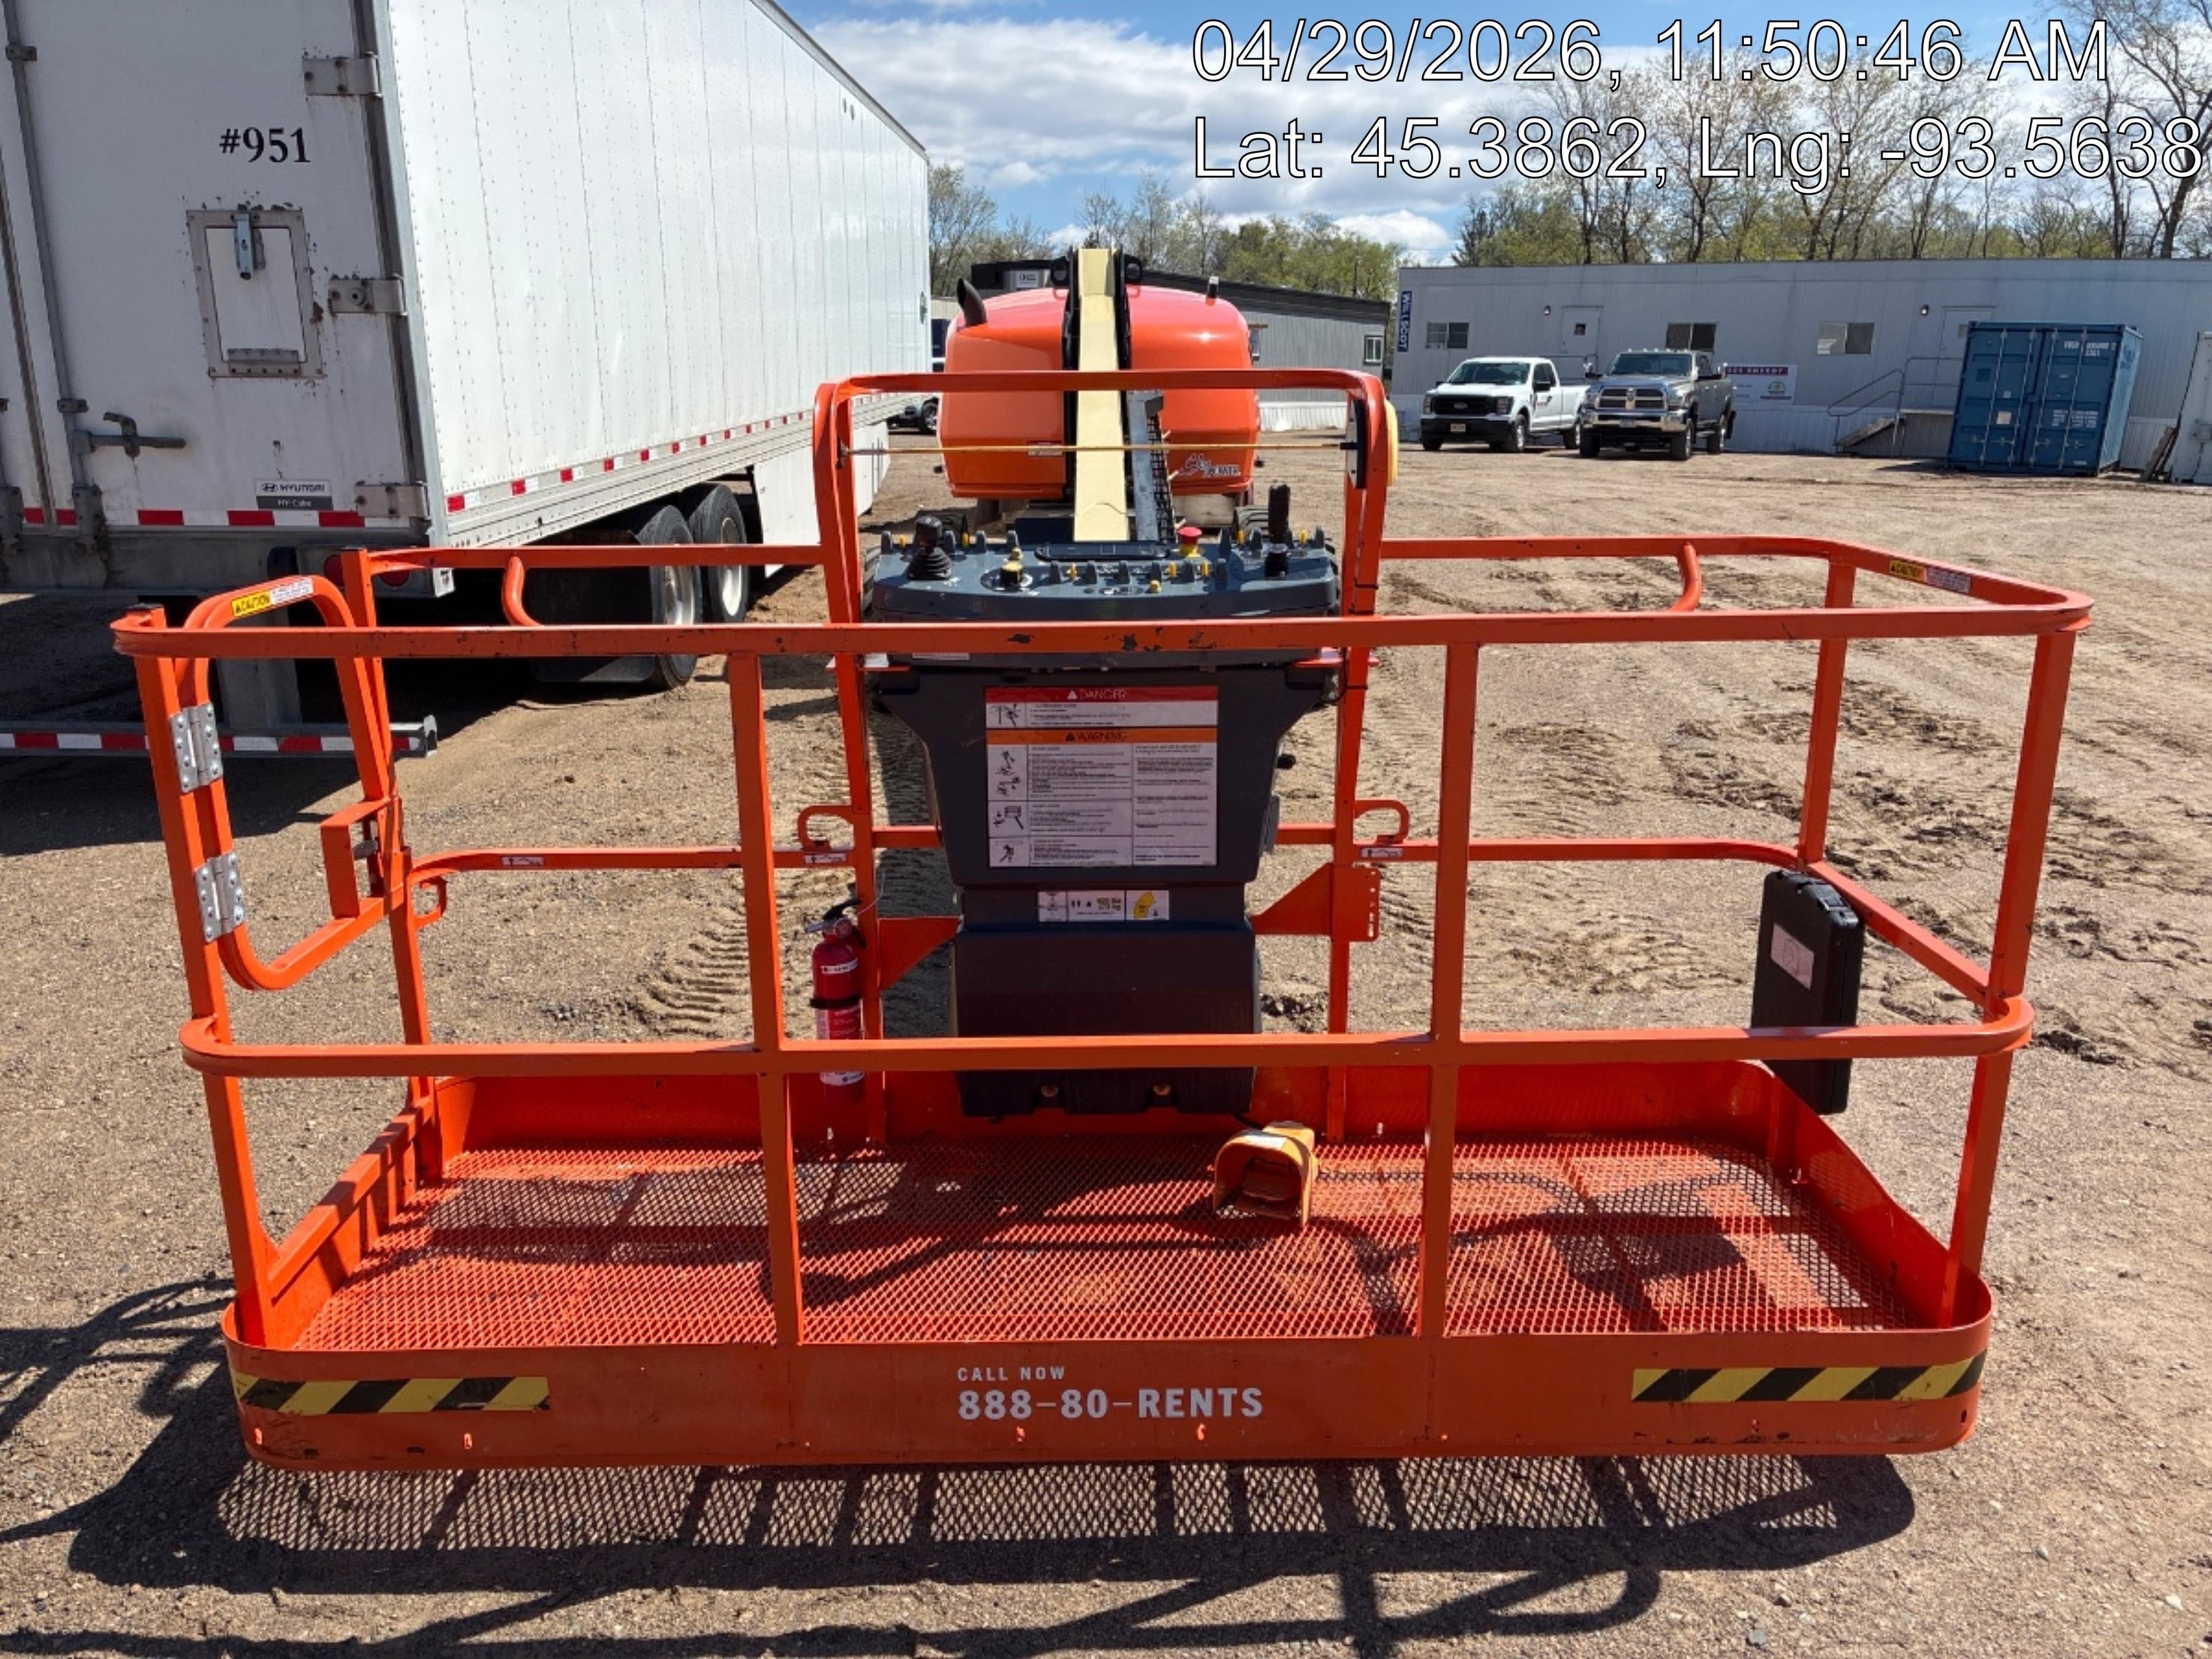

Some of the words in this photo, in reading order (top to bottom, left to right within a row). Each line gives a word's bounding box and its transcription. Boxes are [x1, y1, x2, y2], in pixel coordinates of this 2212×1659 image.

[219, 127, 311, 163] #951
[280, 484, 325, 492] HYUNDAI
[1080, 689, 1127, 699] DANGER
[1076, 732, 1128, 742] WARNING
[957, 1367, 1009, 1381] CALL
[1020, 1366, 1065, 1381] NOW
[958, 1387, 1263, 1420] 888-80-RENTS
